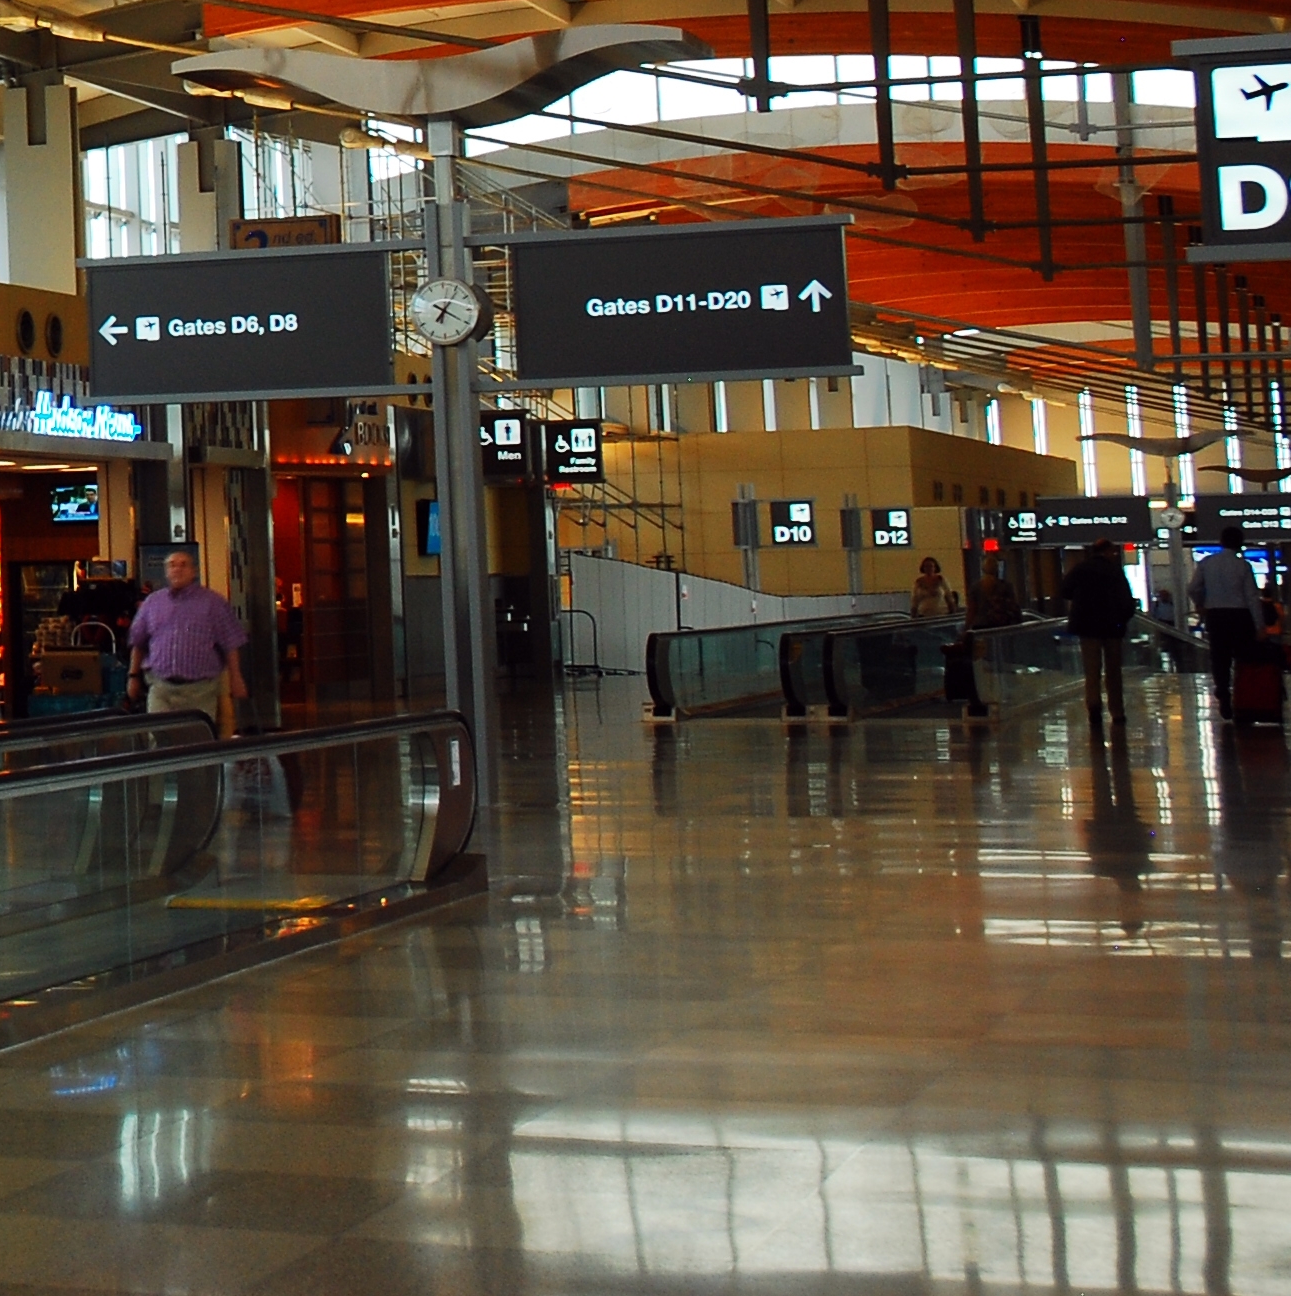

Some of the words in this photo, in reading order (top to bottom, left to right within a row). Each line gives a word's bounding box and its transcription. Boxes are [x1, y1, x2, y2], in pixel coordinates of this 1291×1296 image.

[586, 298, 651, 317] Gates
[655, 290, 752, 313] D11-D20
[168, 318, 227, 337] Gates
[231, 315, 265, 336] D6,
[269, 313, 299, 332] D8
[497, 450, 522, 461] Men
[773, 525, 812, 542] D10
[874, 530, 909, 545] D12
